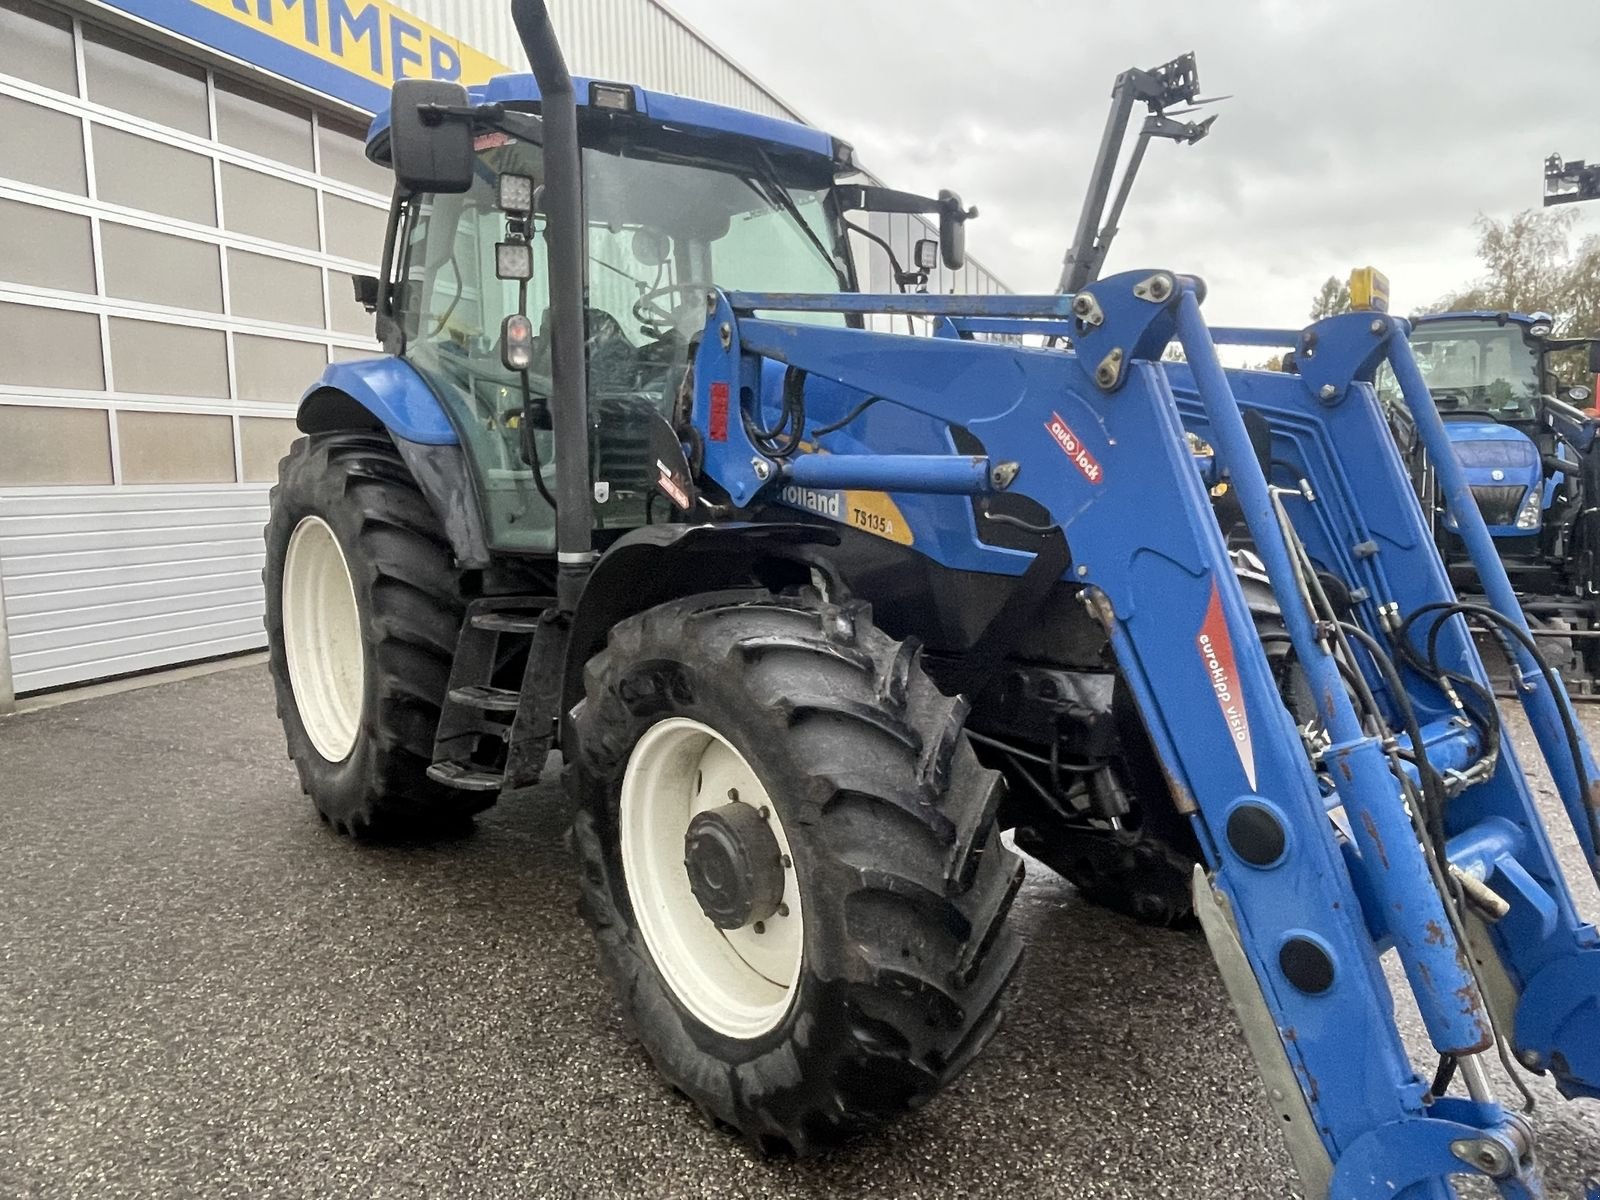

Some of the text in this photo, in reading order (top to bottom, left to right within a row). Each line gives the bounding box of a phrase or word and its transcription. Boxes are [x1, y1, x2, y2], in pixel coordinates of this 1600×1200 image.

[231, 0, 462, 82] MMER
[1052, 422, 1099, 481] auto lock
[854, 508, 893, 535] TS135A
[1199, 634, 1247, 742] eurokipp visio
